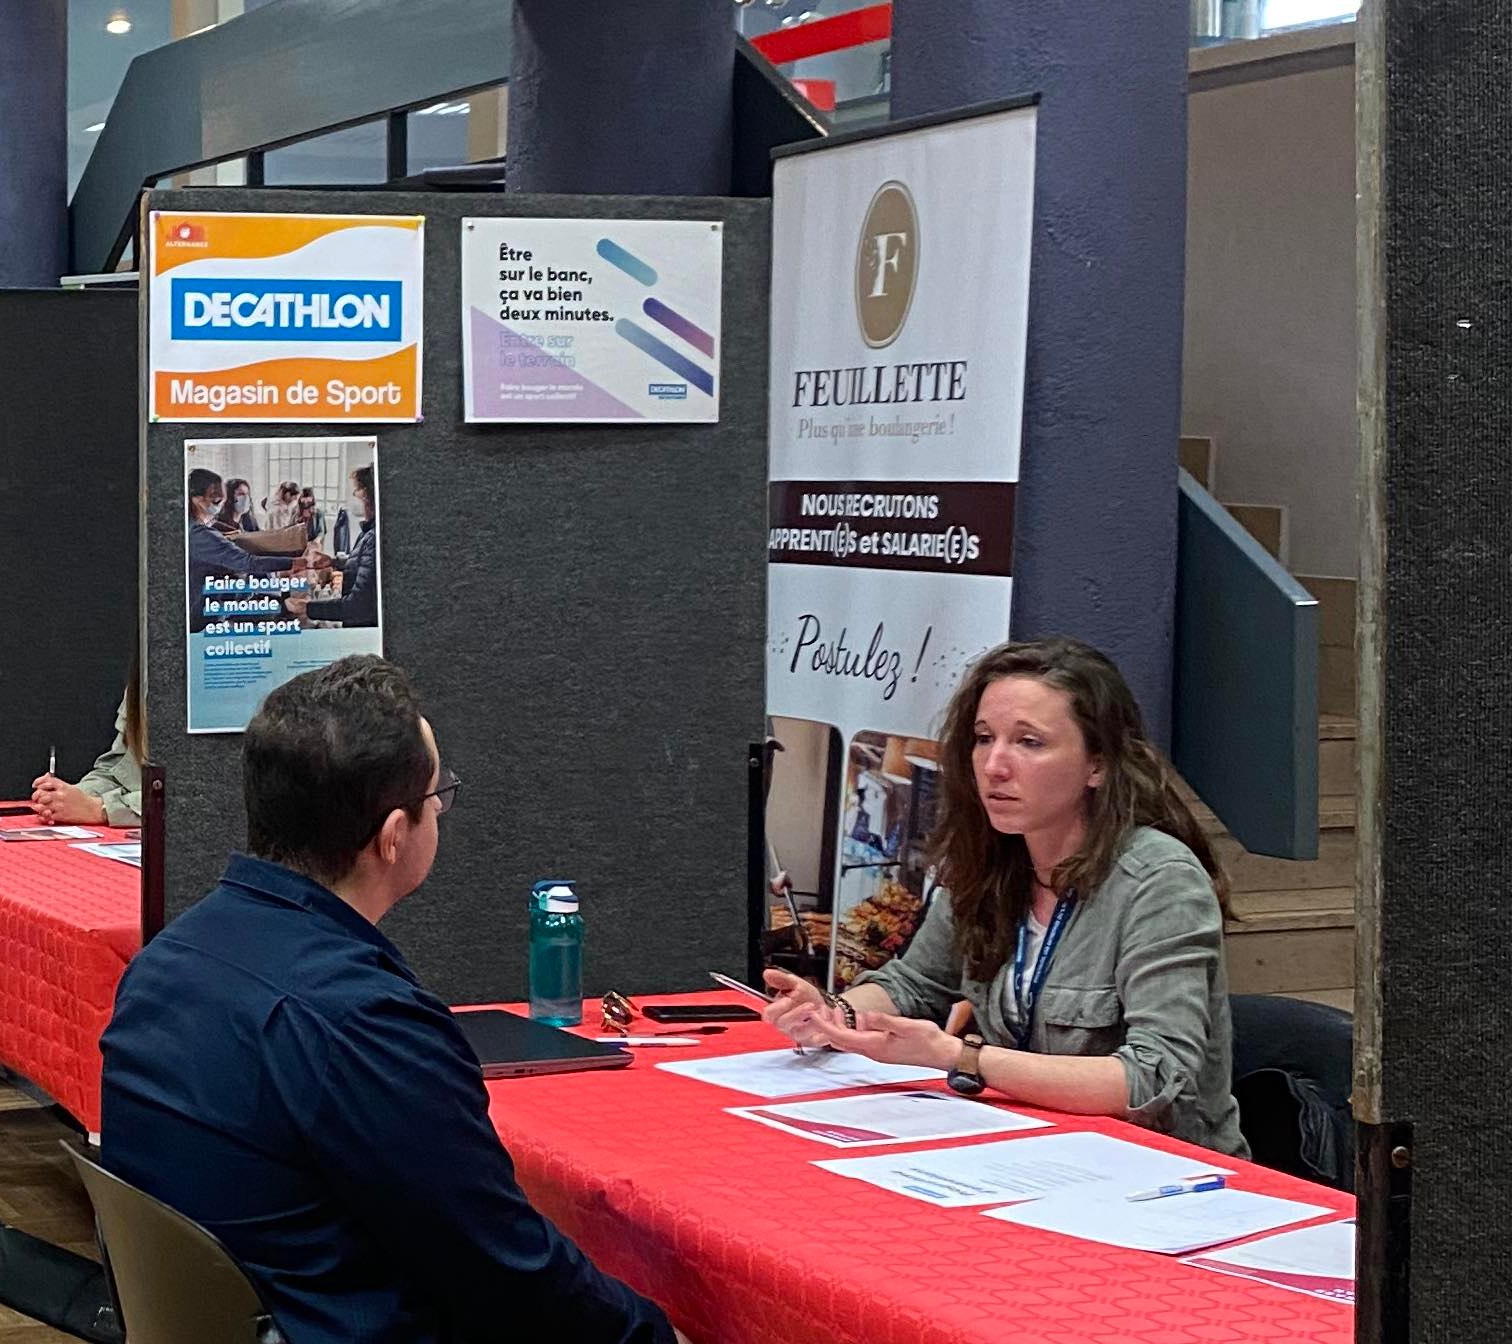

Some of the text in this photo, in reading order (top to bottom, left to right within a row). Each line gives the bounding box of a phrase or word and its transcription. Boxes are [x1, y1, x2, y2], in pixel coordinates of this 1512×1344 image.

[499, 242, 532, 261] Être
[868, 232, 907, 298] F
[499, 267, 593, 284] sur le banc,
[499, 286, 582, 304] ça va bien
[184, 292, 390, 328] DECATHLON
[500, 307, 614, 321] deux minutes.
[499, 331, 574, 348] Entre sur
[500, 350, 576, 368] le terrain
[792, 361, 967, 407] FEUILLETTE
[170, 379, 401, 412] Magasin de Sport
[798, 417, 827, 439] Plus
[801, 494, 939, 519] NOUS RECRUTONS
[860, 532, 880, 554] et
[205, 575, 307, 592] Faire bouger
[205, 597, 280, 612] le monde
[205, 618, 301, 636] est un sport
[206, 640, 271, 656] collectif
[790, 614, 932, 700] Postulez !
